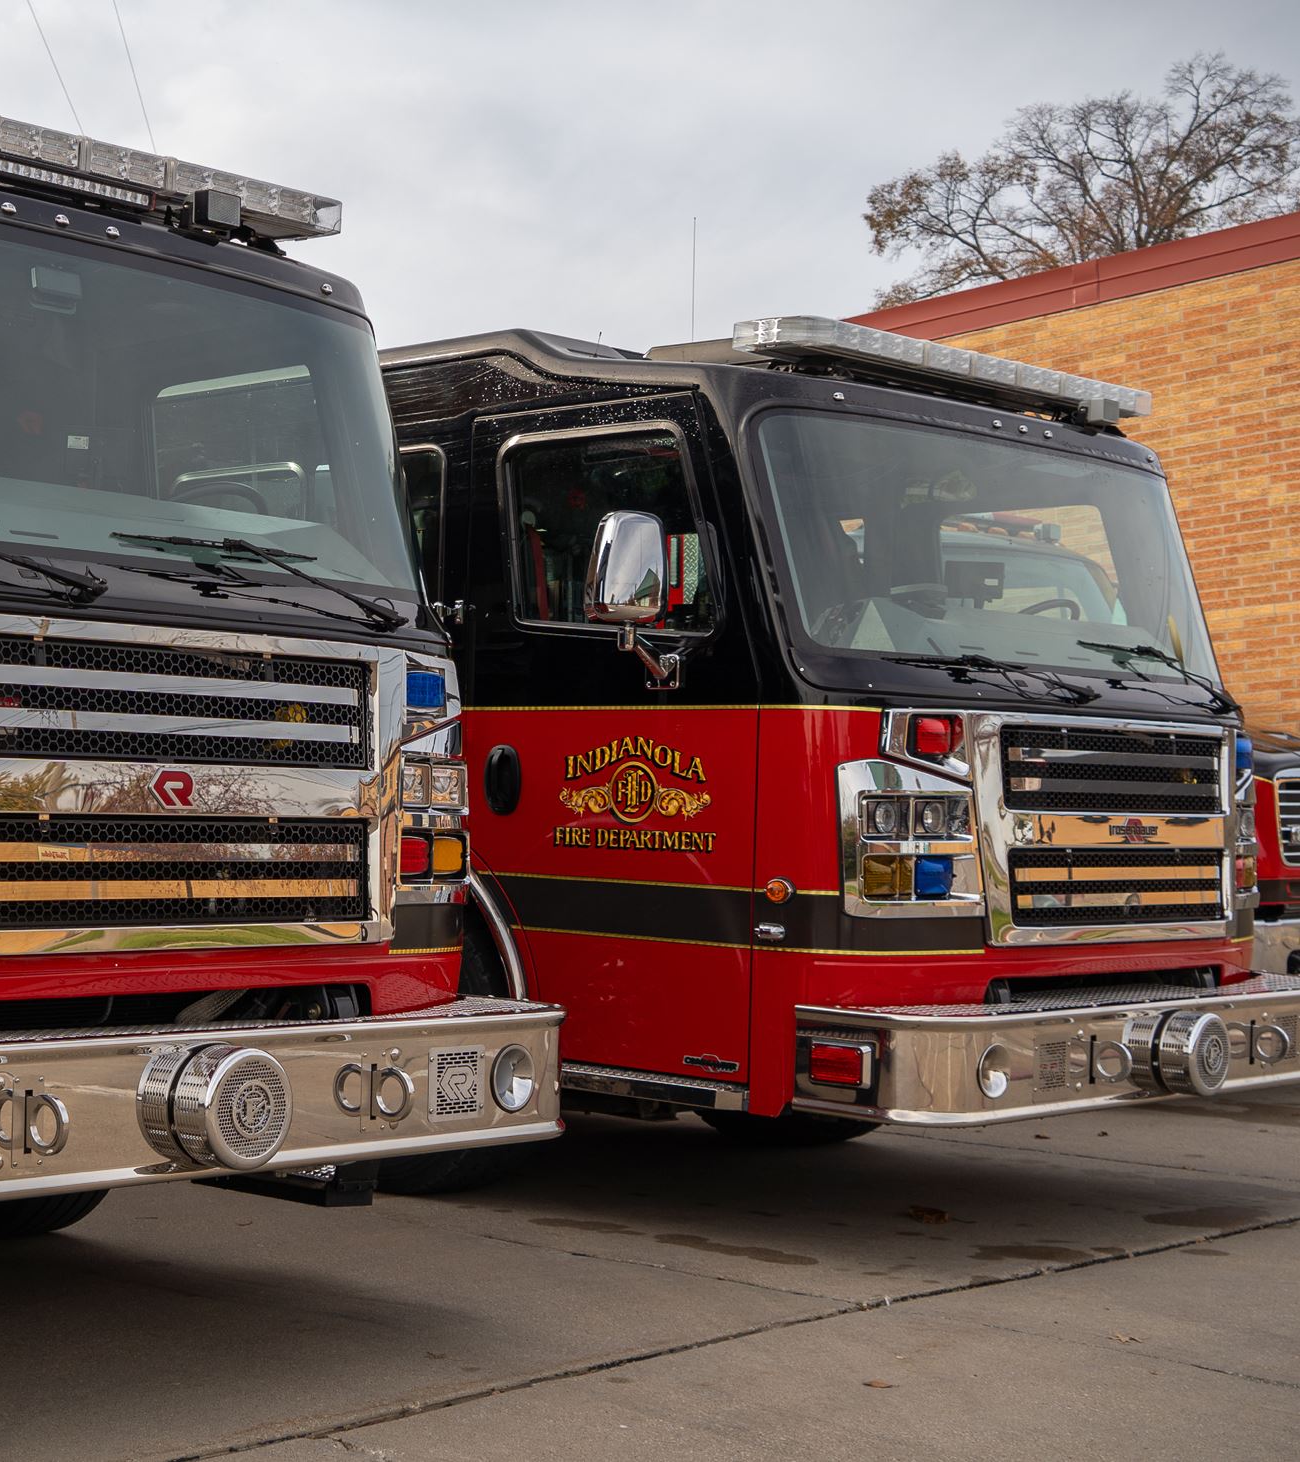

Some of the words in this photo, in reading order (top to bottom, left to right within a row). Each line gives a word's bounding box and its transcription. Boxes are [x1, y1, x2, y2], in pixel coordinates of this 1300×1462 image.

[565, 735, 707, 784] INDIANOLA
[554, 826, 591, 848] FIRE
[595, 828, 717, 853] DEPARTMENT
